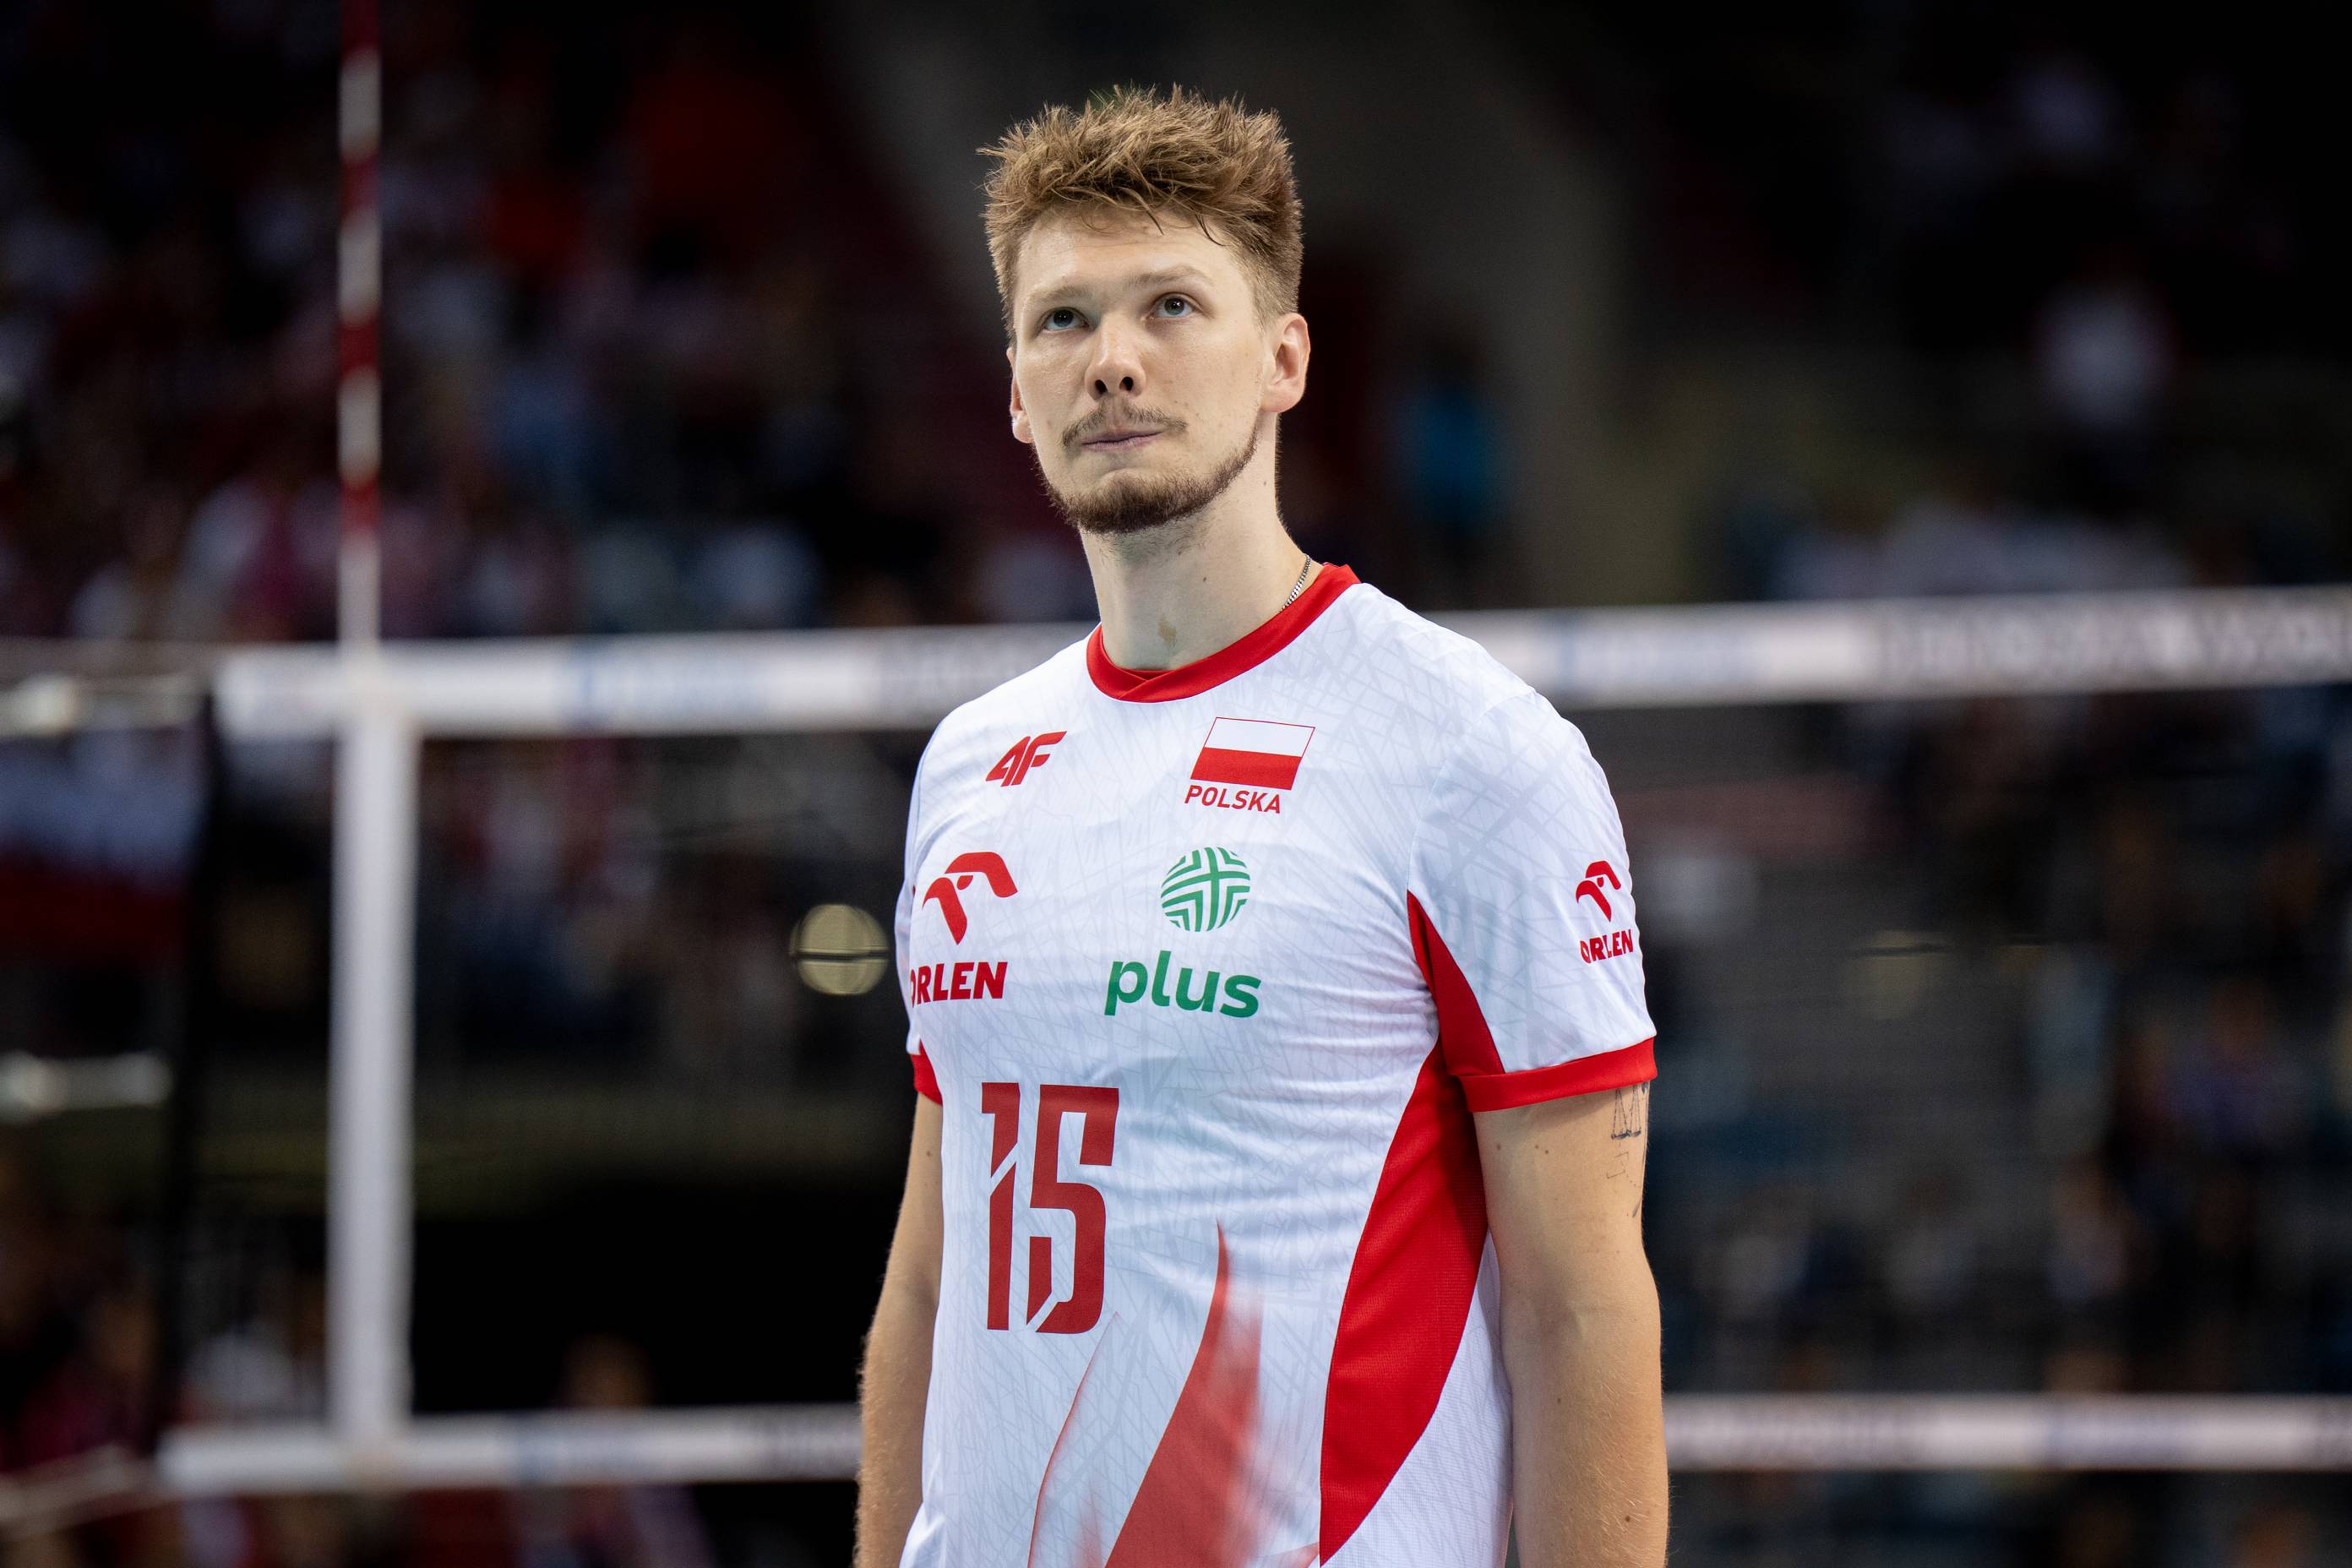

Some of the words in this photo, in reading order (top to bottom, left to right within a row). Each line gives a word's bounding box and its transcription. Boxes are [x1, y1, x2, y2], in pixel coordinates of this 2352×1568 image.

[986, 731, 1066, 787] 4F
[1184, 785, 1281, 814] POLSKA
[1580, 929, 1634, 964] ORLEN
[1104, 950, 1261, 1018] plus
[981, 1081, 1119, 1335] 15
